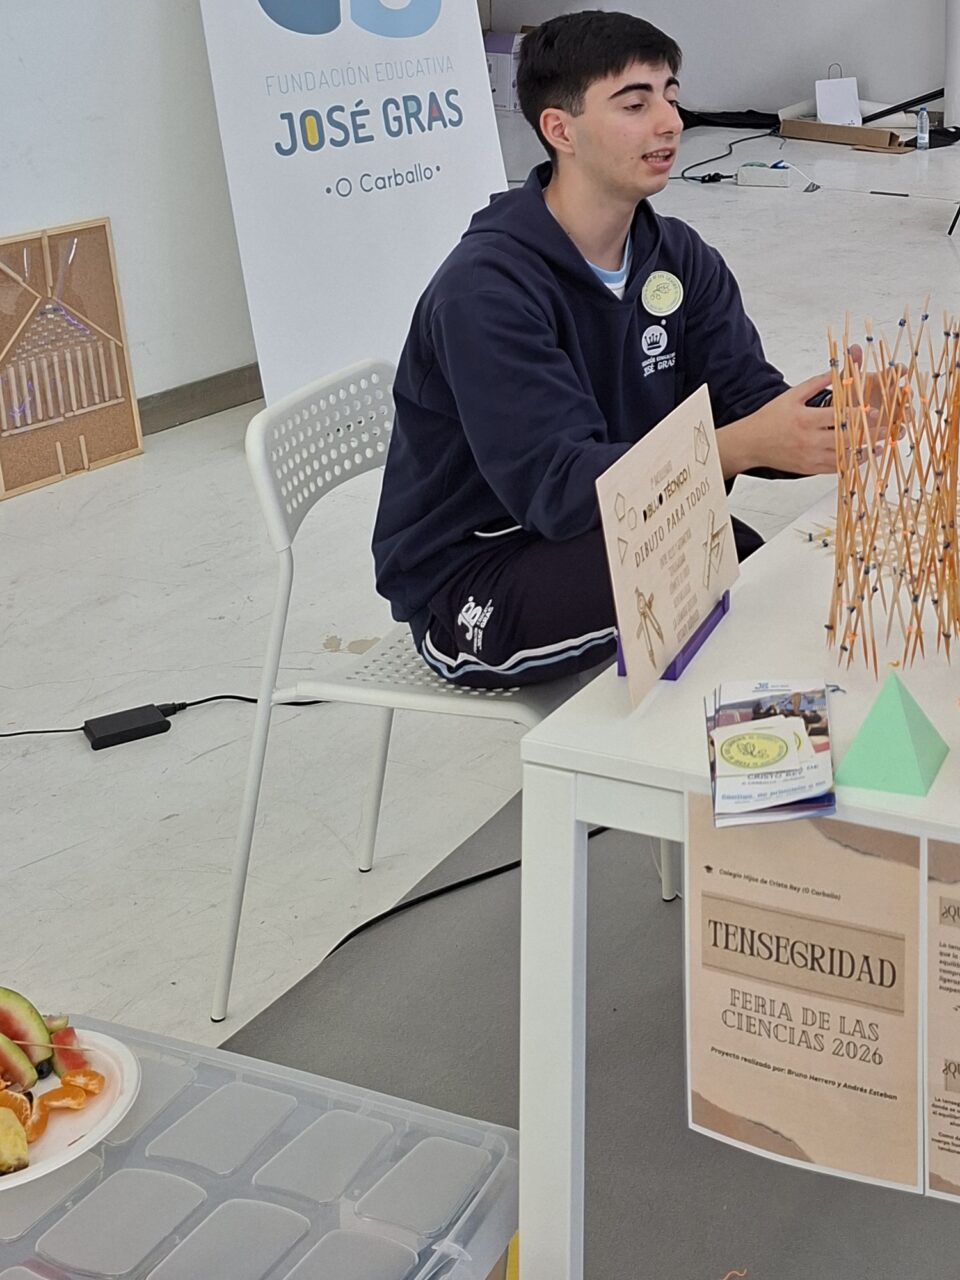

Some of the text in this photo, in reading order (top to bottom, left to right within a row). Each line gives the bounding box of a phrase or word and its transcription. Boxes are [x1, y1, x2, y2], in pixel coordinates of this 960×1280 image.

[265, 55, 454, 96] FUNDACIÓN EDUCATIVA
[274, 88, 464, 157] JOSÉ GRAS
[359, 163, 434, 192] Carballo
[634, 525, 665, 568] DIBUJO
[666, 504, 686, 533] PARA
[686, 476, 711, 510] TODOS
[708, 919, 897, 988] TENSEGRIDAD
[722, 1008, 884, 1066] CIENCIAS 2026
[730, 988, 880, 1042] FERIA DE LAS
[710, 1046, 740, 1061] Proyecto
[741, 1057, 772, 1070] realizado
[772, 1065, 786, 1075] por:
[787, 1068, 808, 1080] Bruno
[810, 1074, 836, 1087] Herrero
[842, 1082, 868, 1095] Andrés
[869, 1088, 898, 1101] Esteban
